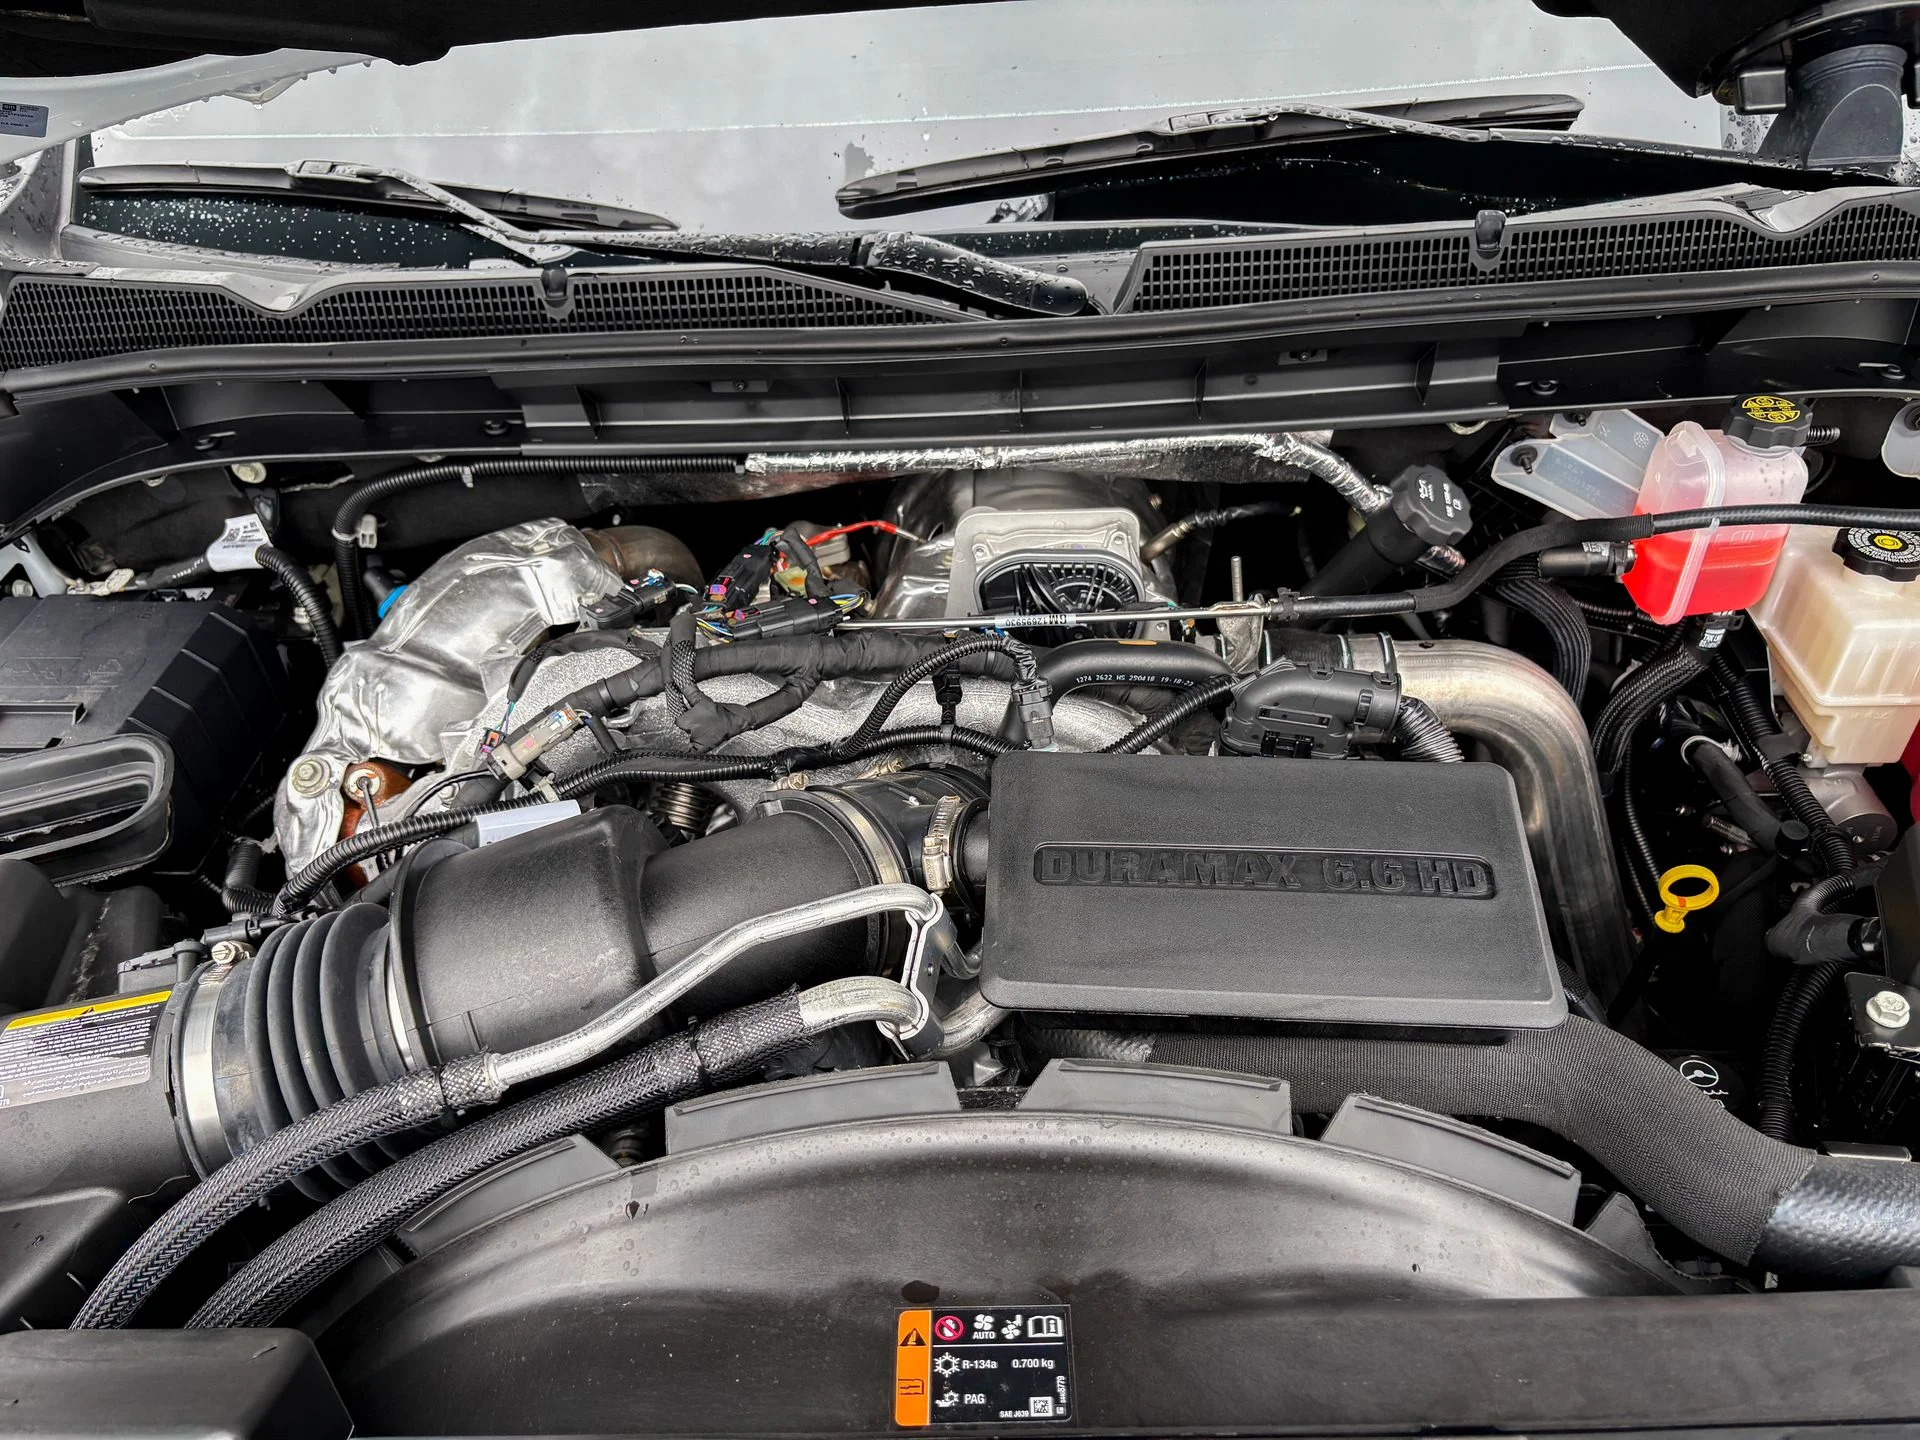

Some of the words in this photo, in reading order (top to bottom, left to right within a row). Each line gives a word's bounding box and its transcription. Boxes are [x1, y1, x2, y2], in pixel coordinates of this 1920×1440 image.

[1095, 674, 1113, 682] 2622
[1040, 850, 1301, 888] DURAMAX
[1322, 857, 1405, 892] 6.6
[1417, 860, 1489, 895] HD
[972, 1331, 996, 1340] AUTO
[962, 1359, 998, 1369] R-134a
[1012, 1359, 1039, 1369] 0.700
[1041, 1358, 1055, 1370] kg
[964, 1394, 986, 1404] PAG
